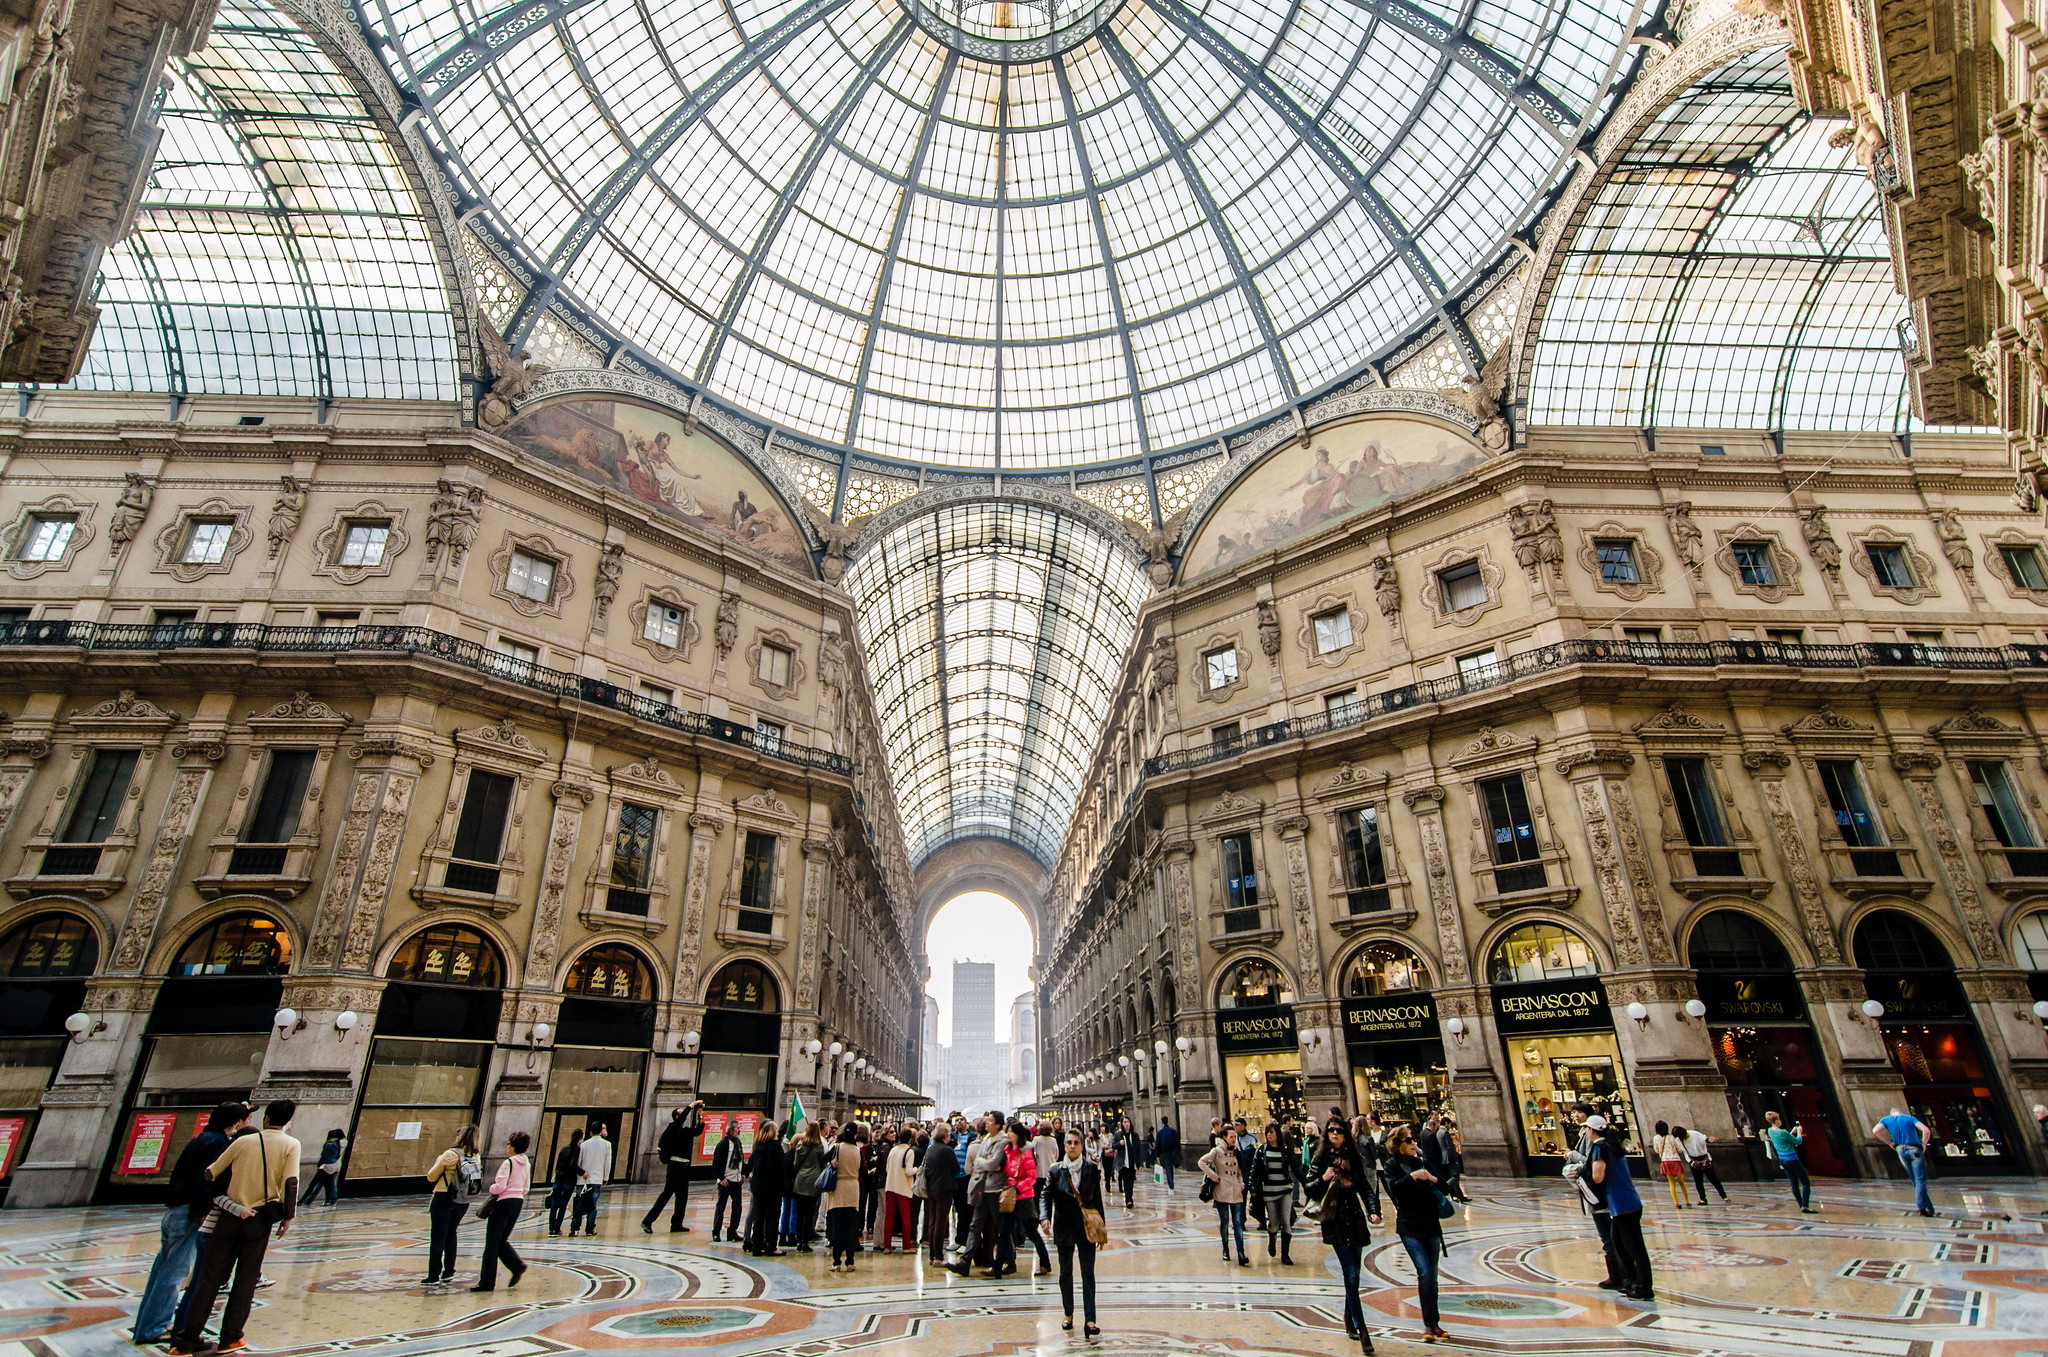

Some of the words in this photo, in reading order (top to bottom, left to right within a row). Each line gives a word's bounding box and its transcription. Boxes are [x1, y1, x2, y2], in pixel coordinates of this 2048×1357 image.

[1501, 991, 1599, 1012] BERNASCONI
[1515, 1011, 1557, 1020] ARGENTERIA
[1557, 1009, 1572, 1017] DAL
[1573, 1008, 1590, 1016] 1872
[1720, 1002, 1784, 1014] SWAROVSKI
[1349, 1005, 1430, 1024] BERNASCONI
[1222, 1017, 1290, 1034] BERNASCONI
[1360, 1022, 1395, 1031] ARGENTERIA
[1408, 1020, 1422, 1028] 1872
[1231, 1032, 1260, 1040] ARGENTERIA
[1272, 1030, 1284, 1038] 1872
